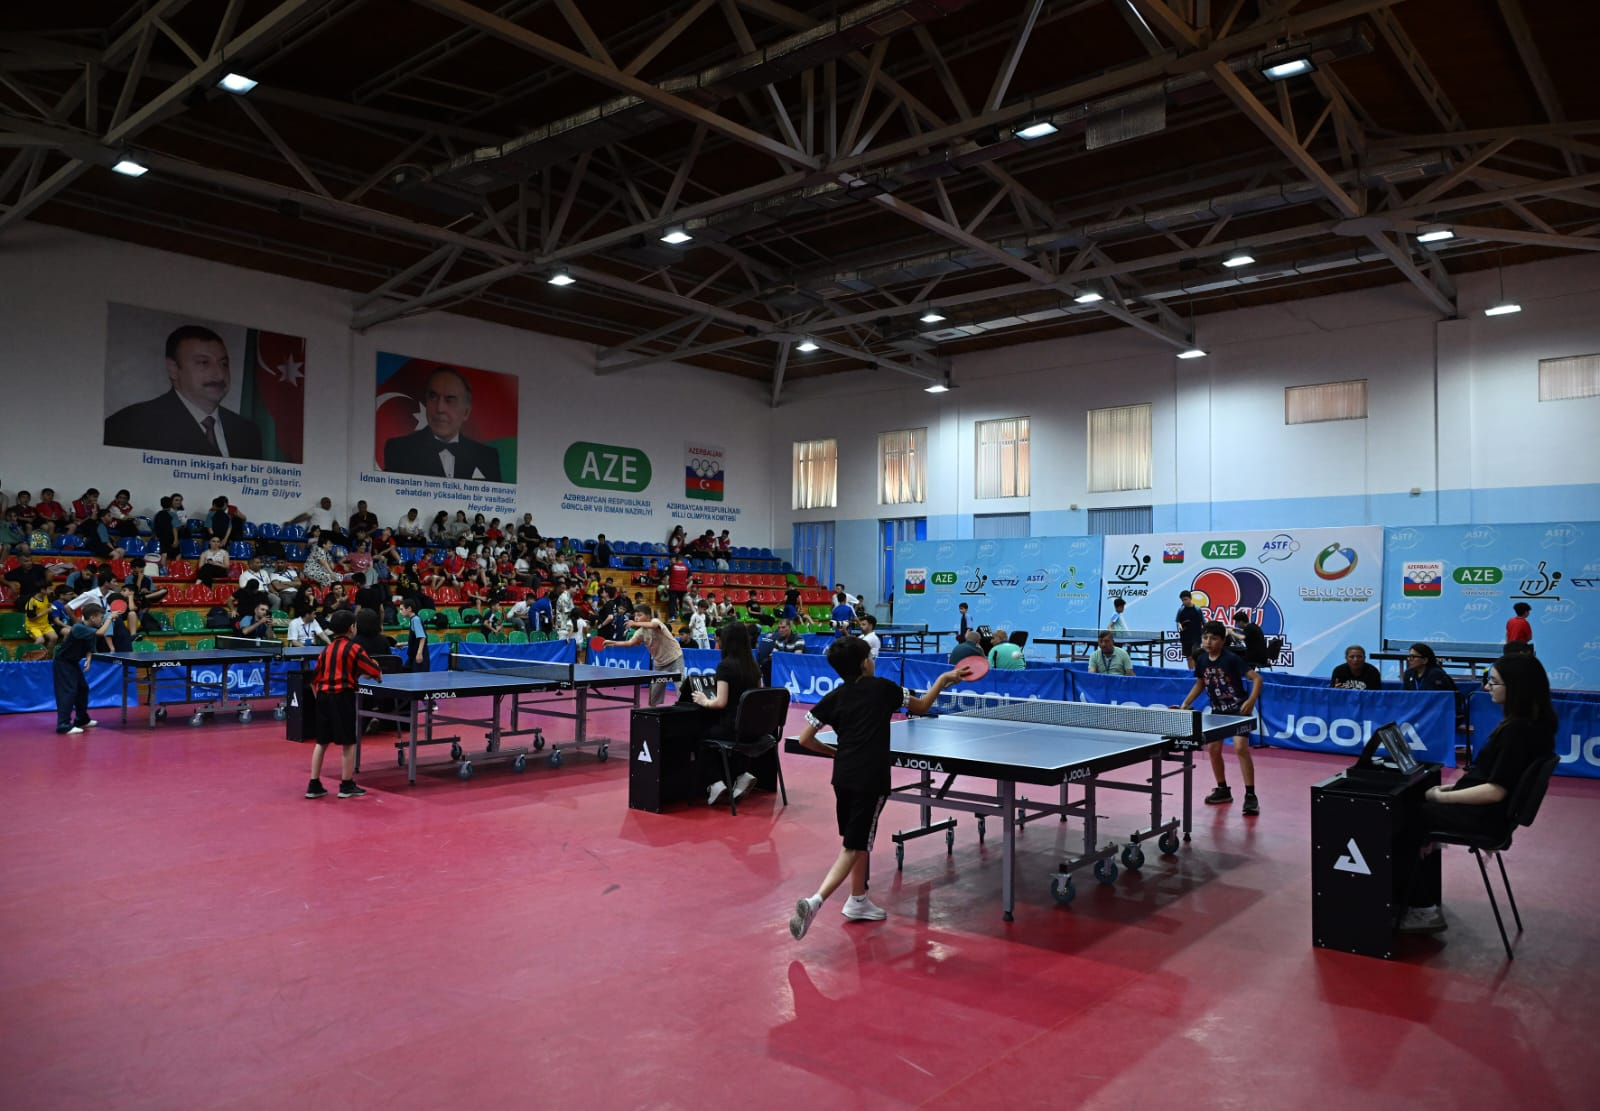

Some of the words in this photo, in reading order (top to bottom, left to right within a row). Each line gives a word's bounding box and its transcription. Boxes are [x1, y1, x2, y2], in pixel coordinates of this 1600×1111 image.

[143, 452, 187, 467] İdmanın
[251, 462, 264, 473] bir
[581, 452, 637, 484] AZE
[272, 488, 302, 499] Əliyev
[473, 493, 482, 502] bir
[563, 493, 607, 504] AZƏRBAYCAN
[1208, 544, 1238, 556] AZE
[1263, 540, 1288, 550] ASTF
[1115, 565, 1149, 576] ITTF
[1461, 569, 1494, 582] AZE
[935, 574, 953, 583] AZE
[1519, 580, 1559, 591] ITTF
[1123, 589, 1149, 597] YEARS
[1299, 586, 1333, 596] Baku
[1336, 586, 1374, 597] 2026
[431, 691, 457, 700] JOOLA
[904, 757, 944, 773] JOOLA
[1069, 766, 1091, 783] JOOLA
